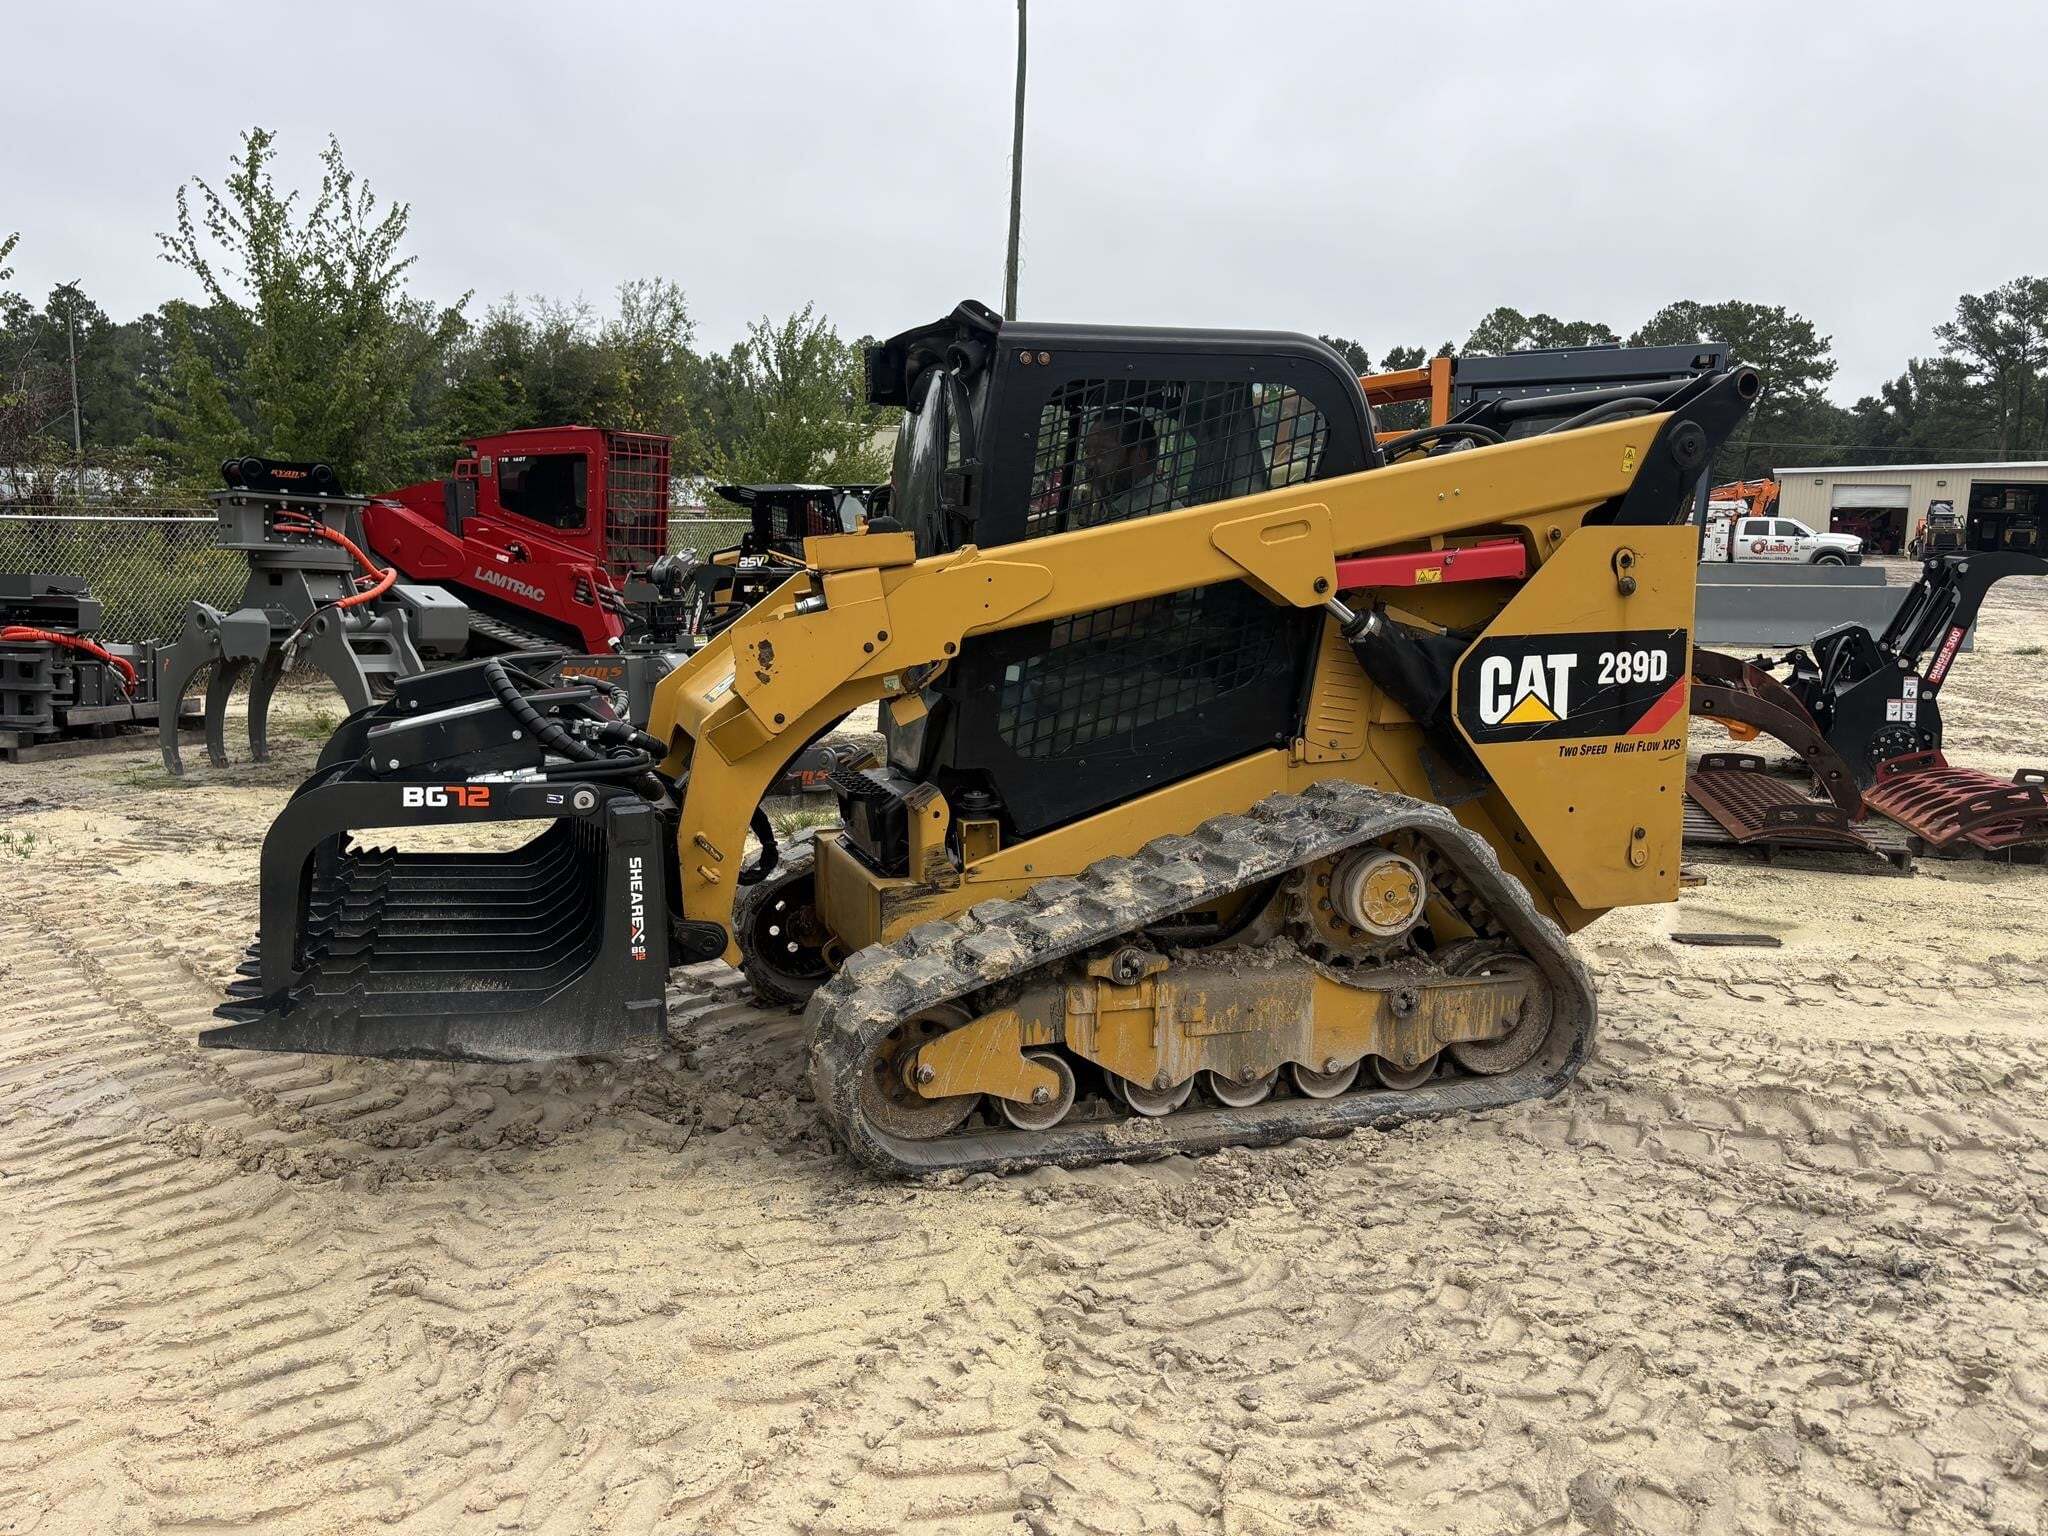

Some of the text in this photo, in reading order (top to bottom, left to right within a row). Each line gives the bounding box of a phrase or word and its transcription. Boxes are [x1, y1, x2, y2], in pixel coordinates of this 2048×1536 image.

[739, 555, 767, 567] asv
[475, 566, 545, 602] LAMTRAC
[1597, 650, 1668, 684] 289D
[1929, 646, 1948, 680] DANGER
[1480, 653, 1578, 725] CAT
[1559, 738, 1681, 757] TWO SPEED HIGH FLOW XPS
[402, 786, 490, 807] BG72
